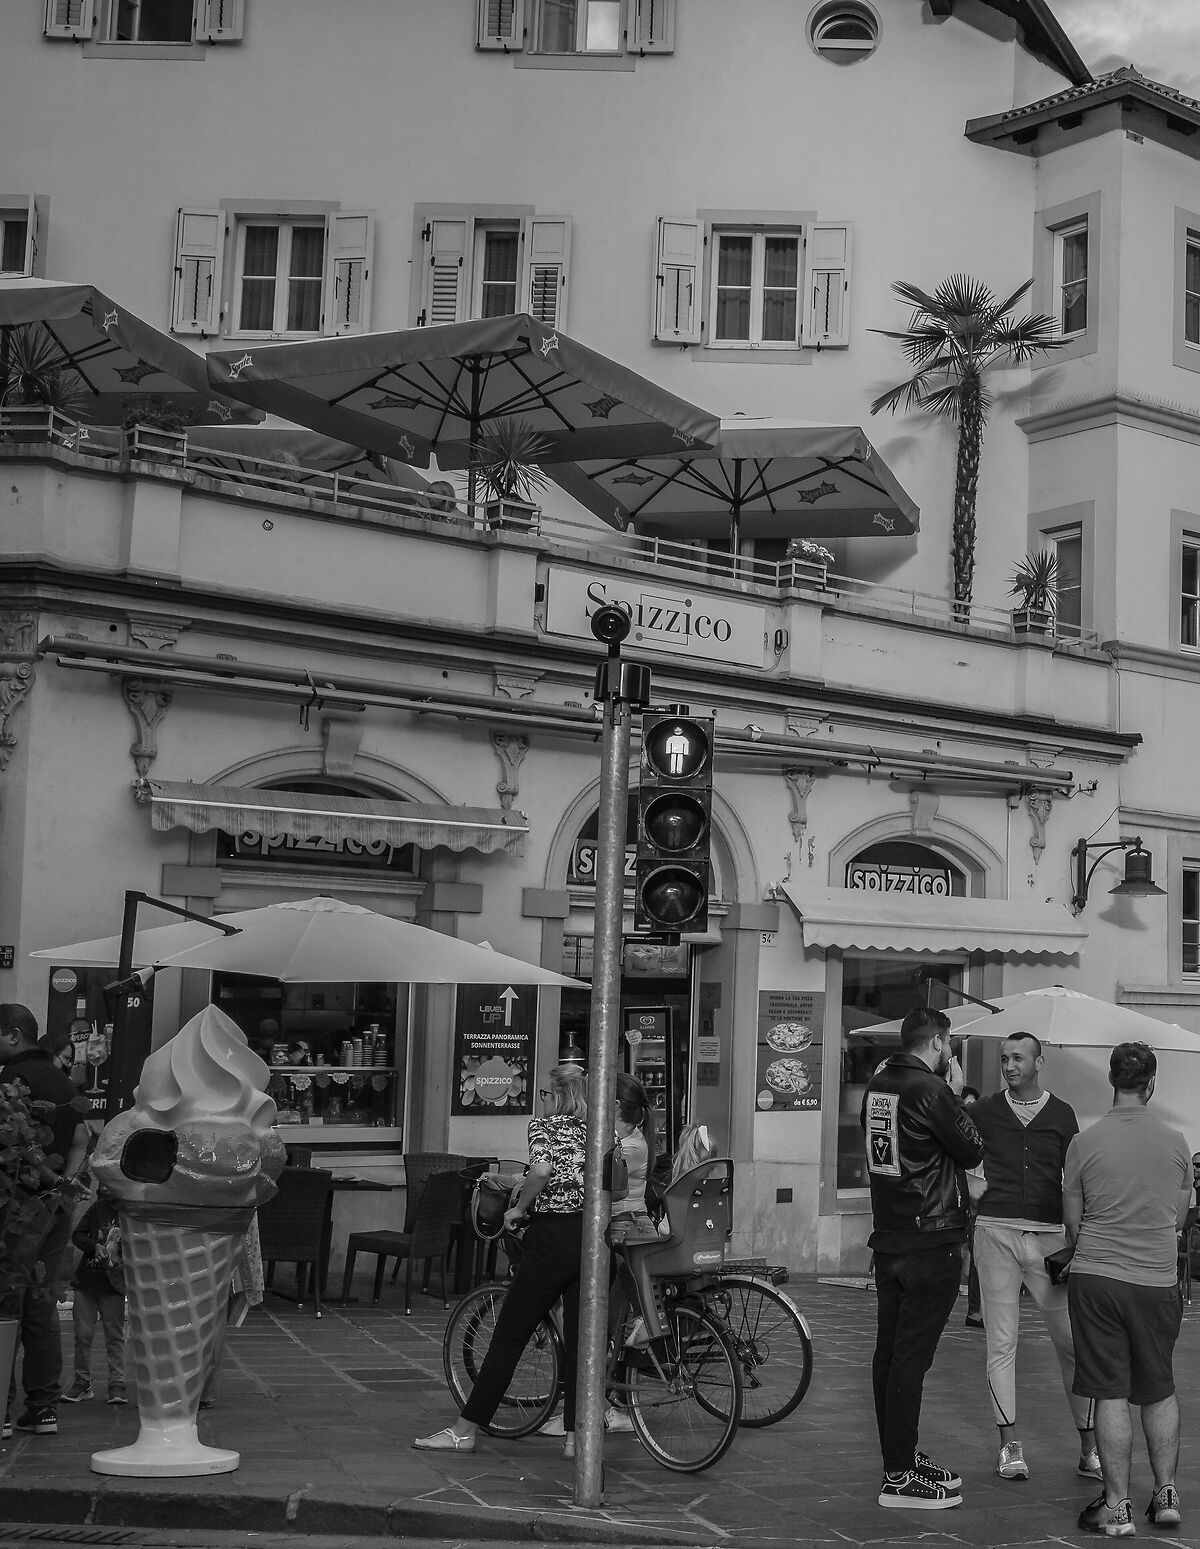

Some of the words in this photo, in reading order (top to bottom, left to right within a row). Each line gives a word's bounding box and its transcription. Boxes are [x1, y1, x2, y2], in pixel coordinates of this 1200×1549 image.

[853, 865, 948, 897] spizzico
[479, 1005, 505, 1013] LEVEL
[482, 1013, 501, 1024] UP
[476, 1077, 512, 1087] spizzico
